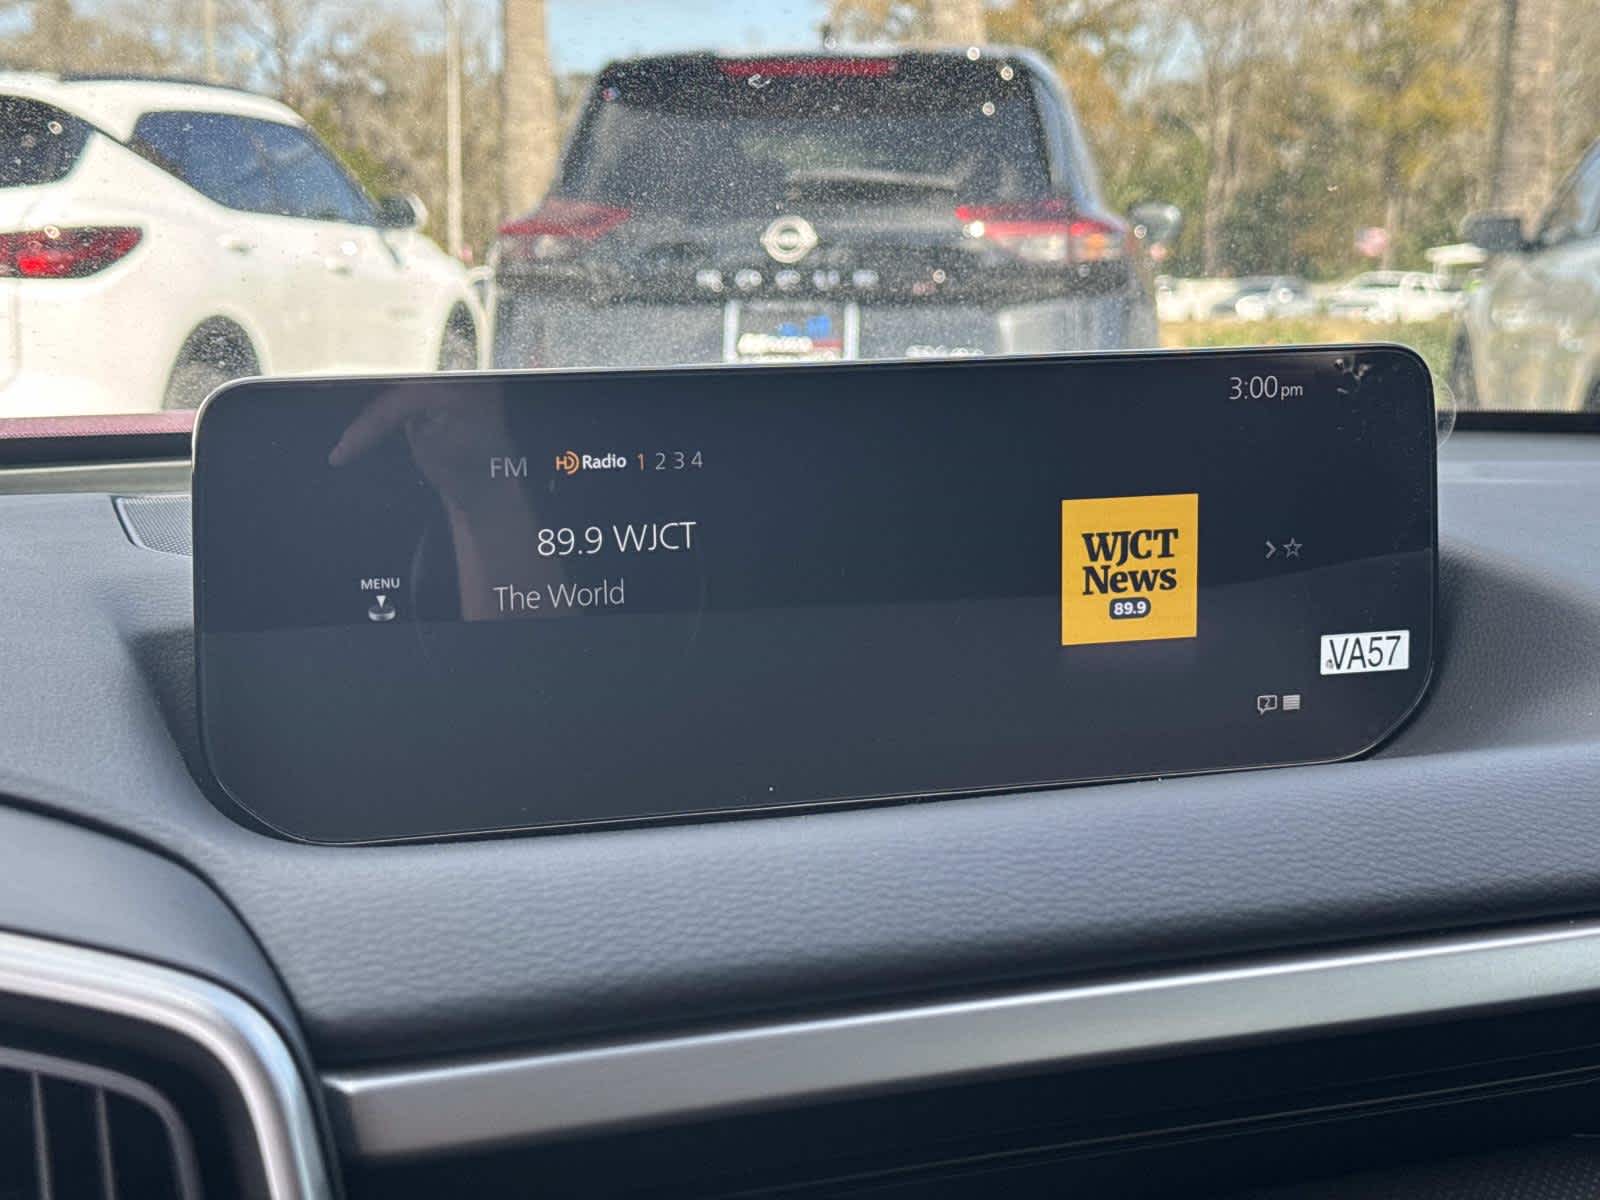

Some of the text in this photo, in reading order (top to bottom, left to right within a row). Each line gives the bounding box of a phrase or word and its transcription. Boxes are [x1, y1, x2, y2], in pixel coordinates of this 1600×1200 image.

[490, 456, 529, 478] FM
[582, 453, 627, 470] Radio
[637, 453, 645, 471] 1
[537, 521, 697, 556] 89.9 WJCT
[1081, 528, 1179, 567] WJCT
[360, 577, 400, 590] MENU
[493, 577, 625, 612] The World
[1082, 565, 1178, 596] News
[1113, 600, 1147, 616] 89.9
[1329, 635, 1402, 671] VA57
